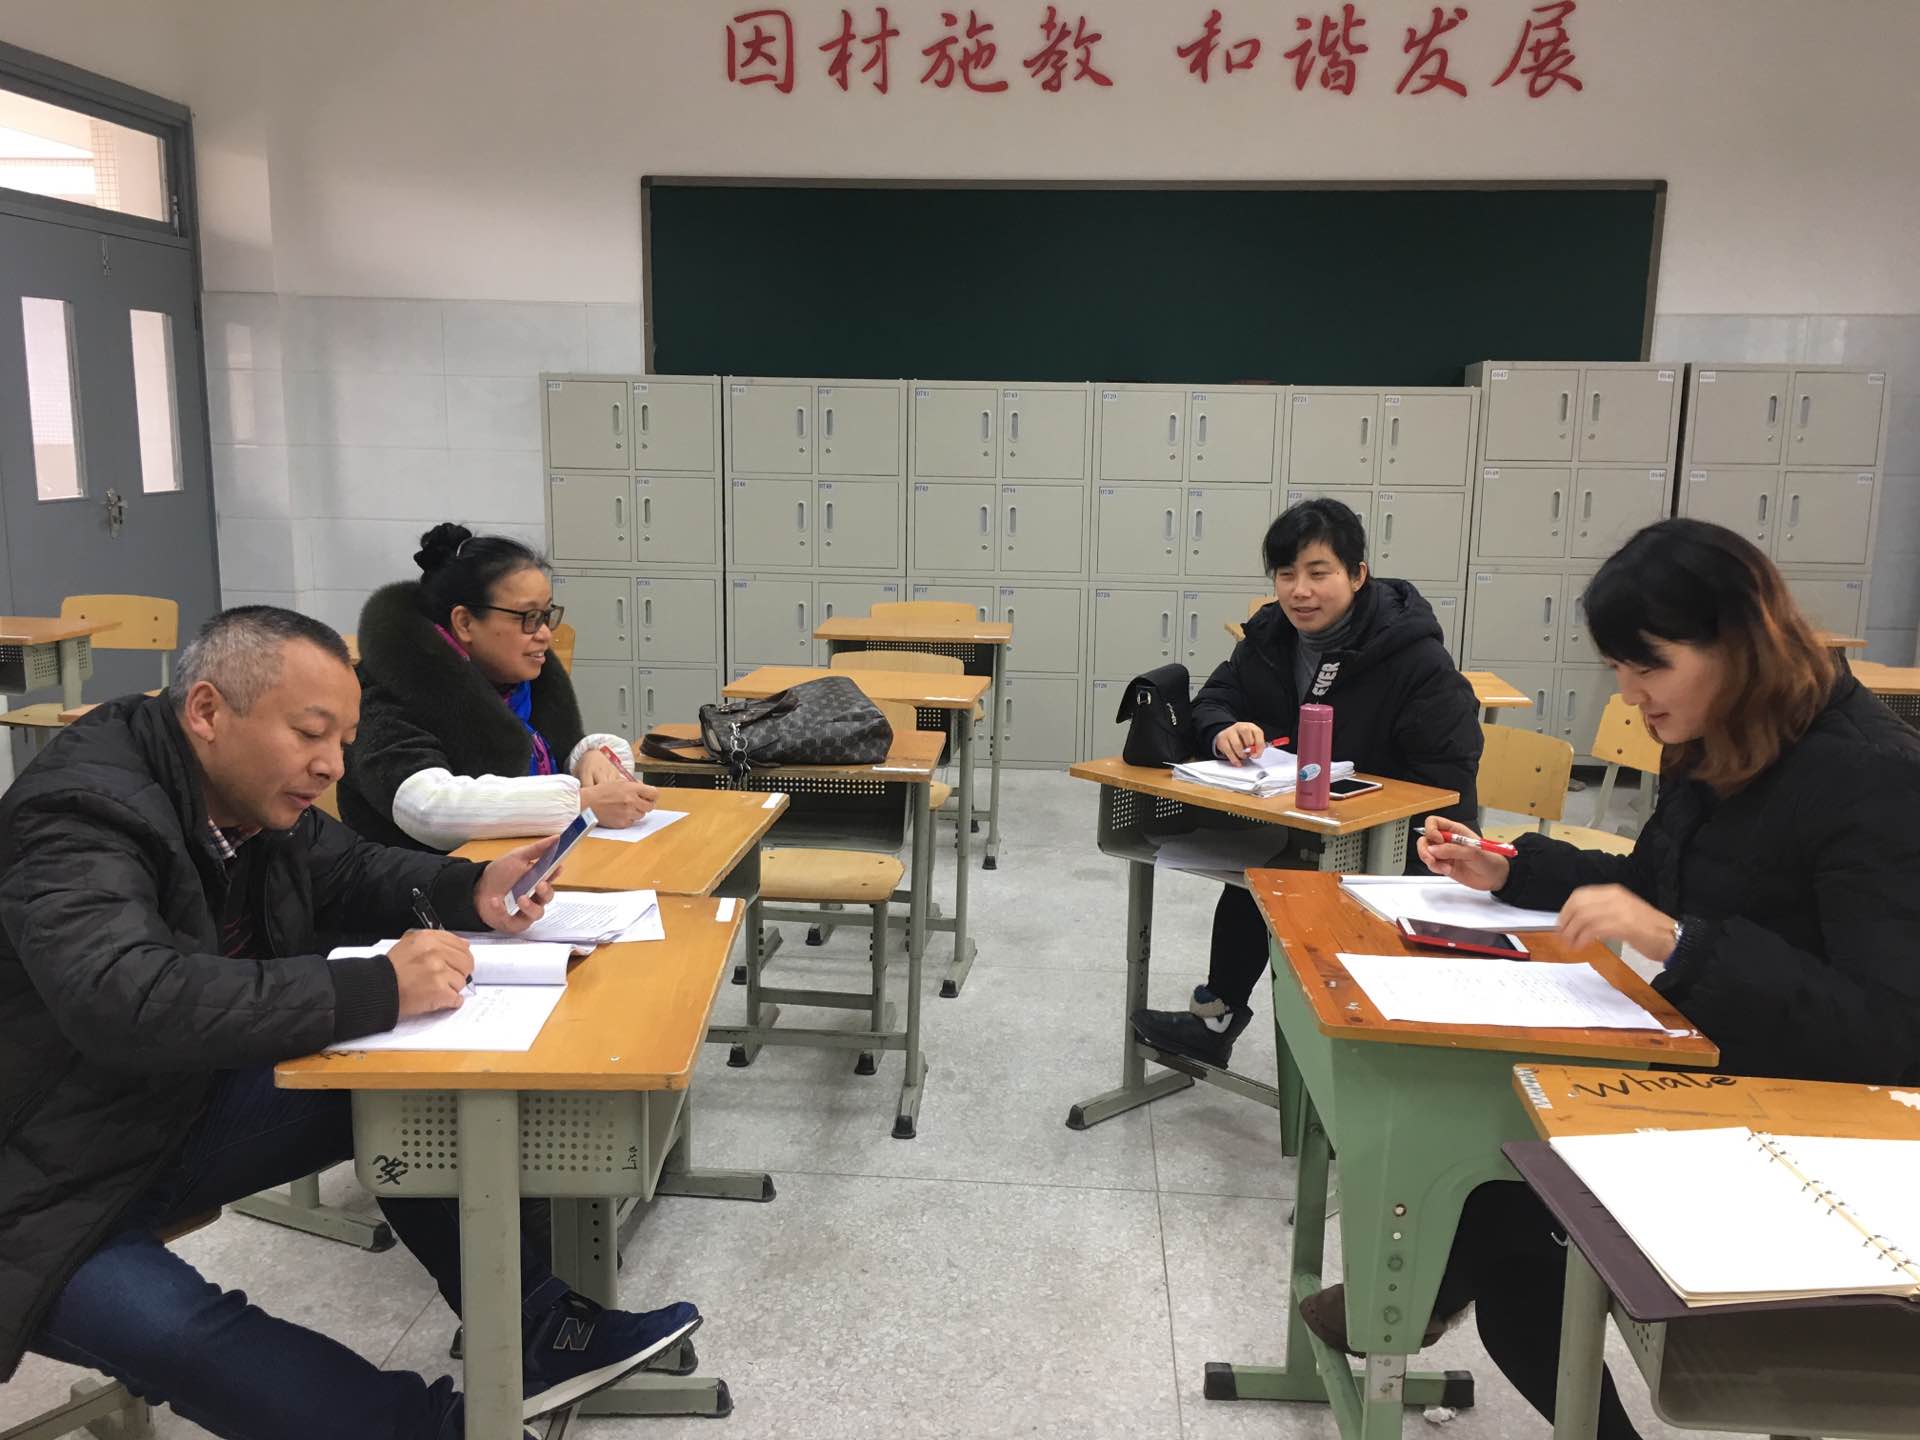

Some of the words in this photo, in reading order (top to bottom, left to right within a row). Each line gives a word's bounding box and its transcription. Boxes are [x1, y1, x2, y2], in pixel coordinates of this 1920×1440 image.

[726, 6, 1114, 94] 因材施教
[1177, 0, 1583, 97] 和谐发展
